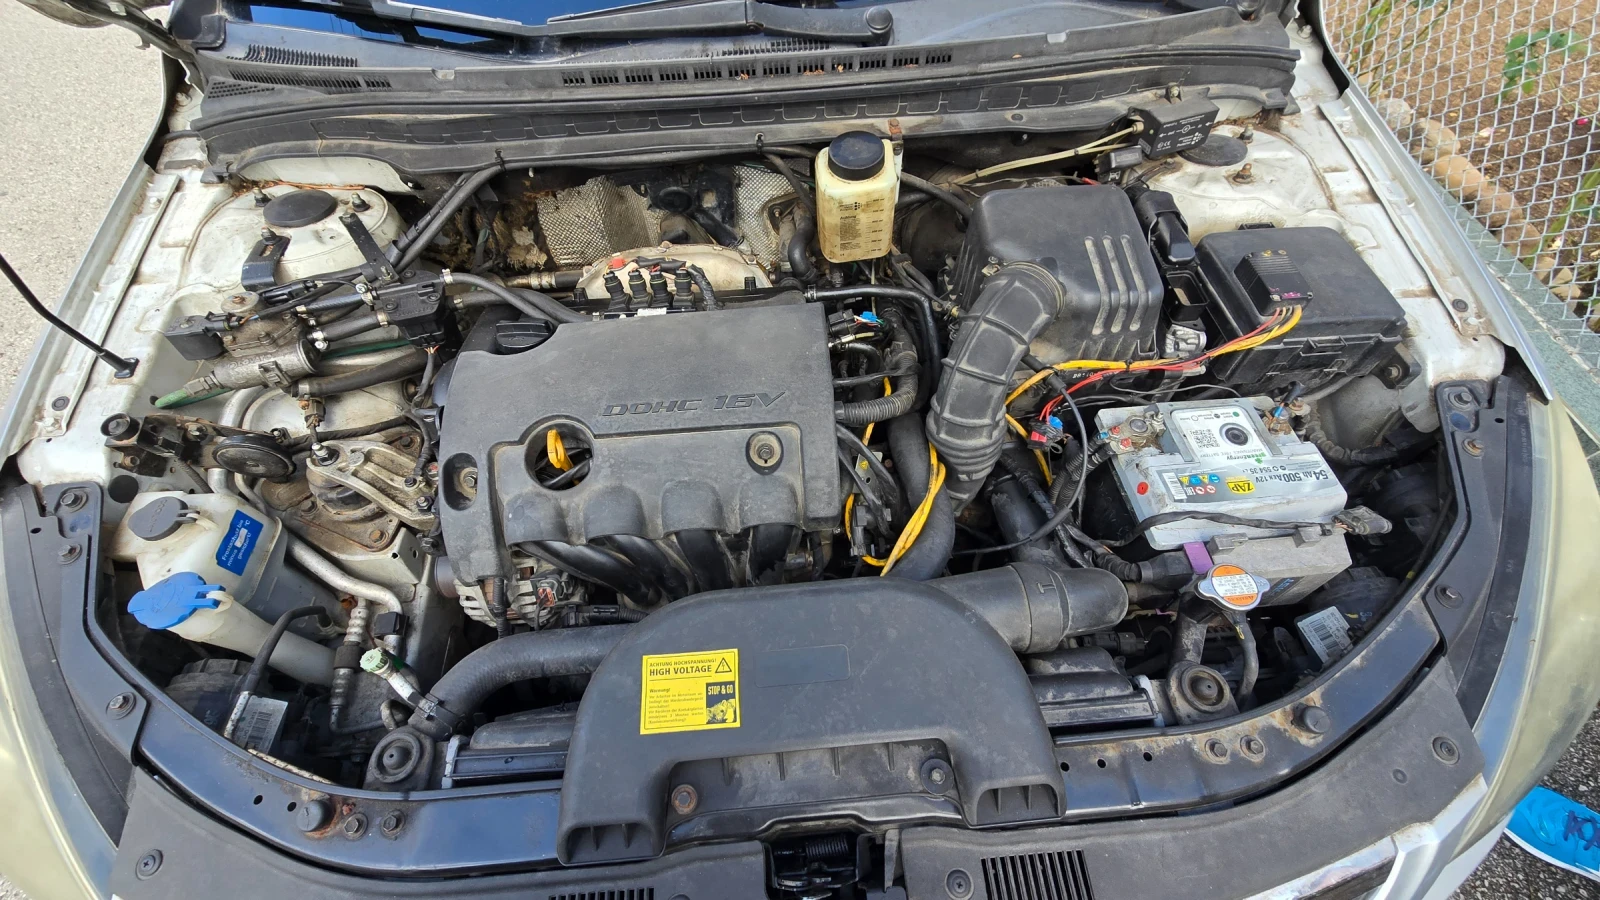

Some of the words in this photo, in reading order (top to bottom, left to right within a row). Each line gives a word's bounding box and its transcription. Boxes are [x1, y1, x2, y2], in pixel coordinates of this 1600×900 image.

[601, 399, 703, 417] DOHC
[713, 391, 786, 410] 16V
[1255, 475, 1268, 483] 12V
[1231, 482, 1254, 492] ZAP
[673, 658, 717, 666] HOCHSPANNUNG!
[649, 667, 671, 677] HIGH
[673, 664, 712, 675] VOLTAGE
[707, 685, 721, 695] STOP
[721, 685, 726, 694] &
[726, 684, 734, 694] GO
